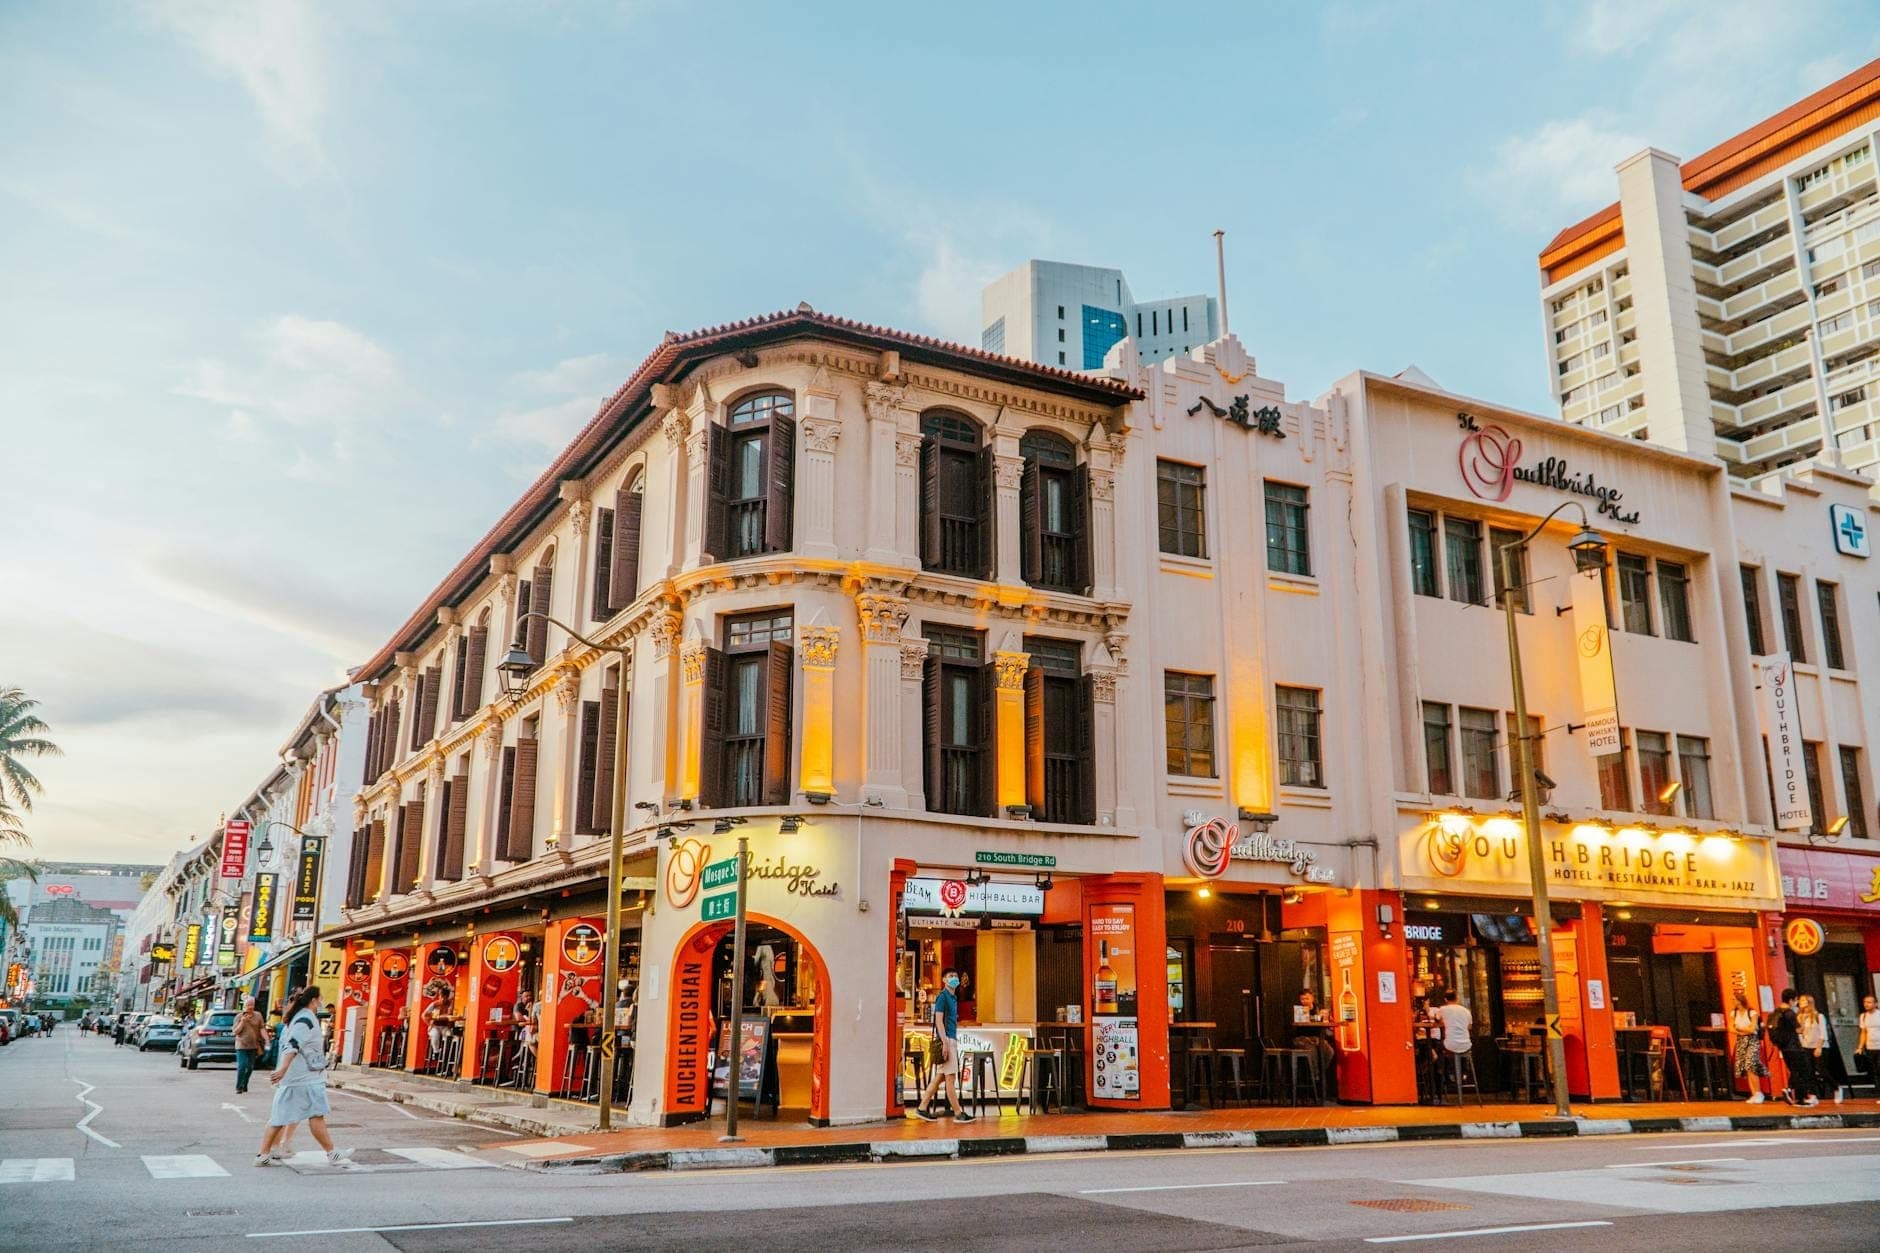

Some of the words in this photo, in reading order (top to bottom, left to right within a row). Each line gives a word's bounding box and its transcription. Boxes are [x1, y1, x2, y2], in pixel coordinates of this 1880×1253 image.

[1457, 412, 1482, 433] The
[1459, 425, 1623, 515] Southbridge
[1588, 718, 1616, 728] FAMOUS
[1588, 727, 1617, 738] WHISKY
[1774, 675, 1797, 804] SOUTHBRIDGE
[1589, 737, 1617, 748] HOTEL
[1779, 810, 1809, 819] HOTEL
[1183, 817, 1316, 880] Southbridge
[1449, 834, 1697, 871] SOUHBRIDGE
[993, 854, 1017, 864] South
[1018, 856, 1043, 866] Bridge
[1044, 857, 1055, 866] Rd
[705, 867, 730, 884] Mosque
[1554, 868, 1592, 881] HOTEL
[1608, 872, 1681, 887] RESTAURANT
[1696, 879, 1717, 889] BAR
[970, 893, 1018, 904] HIGHBALL
[1022, 895, 1041, 904] BAR
[1226, 919, 1245, 932] 210
[320, 960, 342, 975] 27
[676, 962, 703, 1105] AUCHENTOSHAN
[723, 1022, 753, 1032] LUCH
[1096, 1034, 1134, 1044] HIGHBALL
